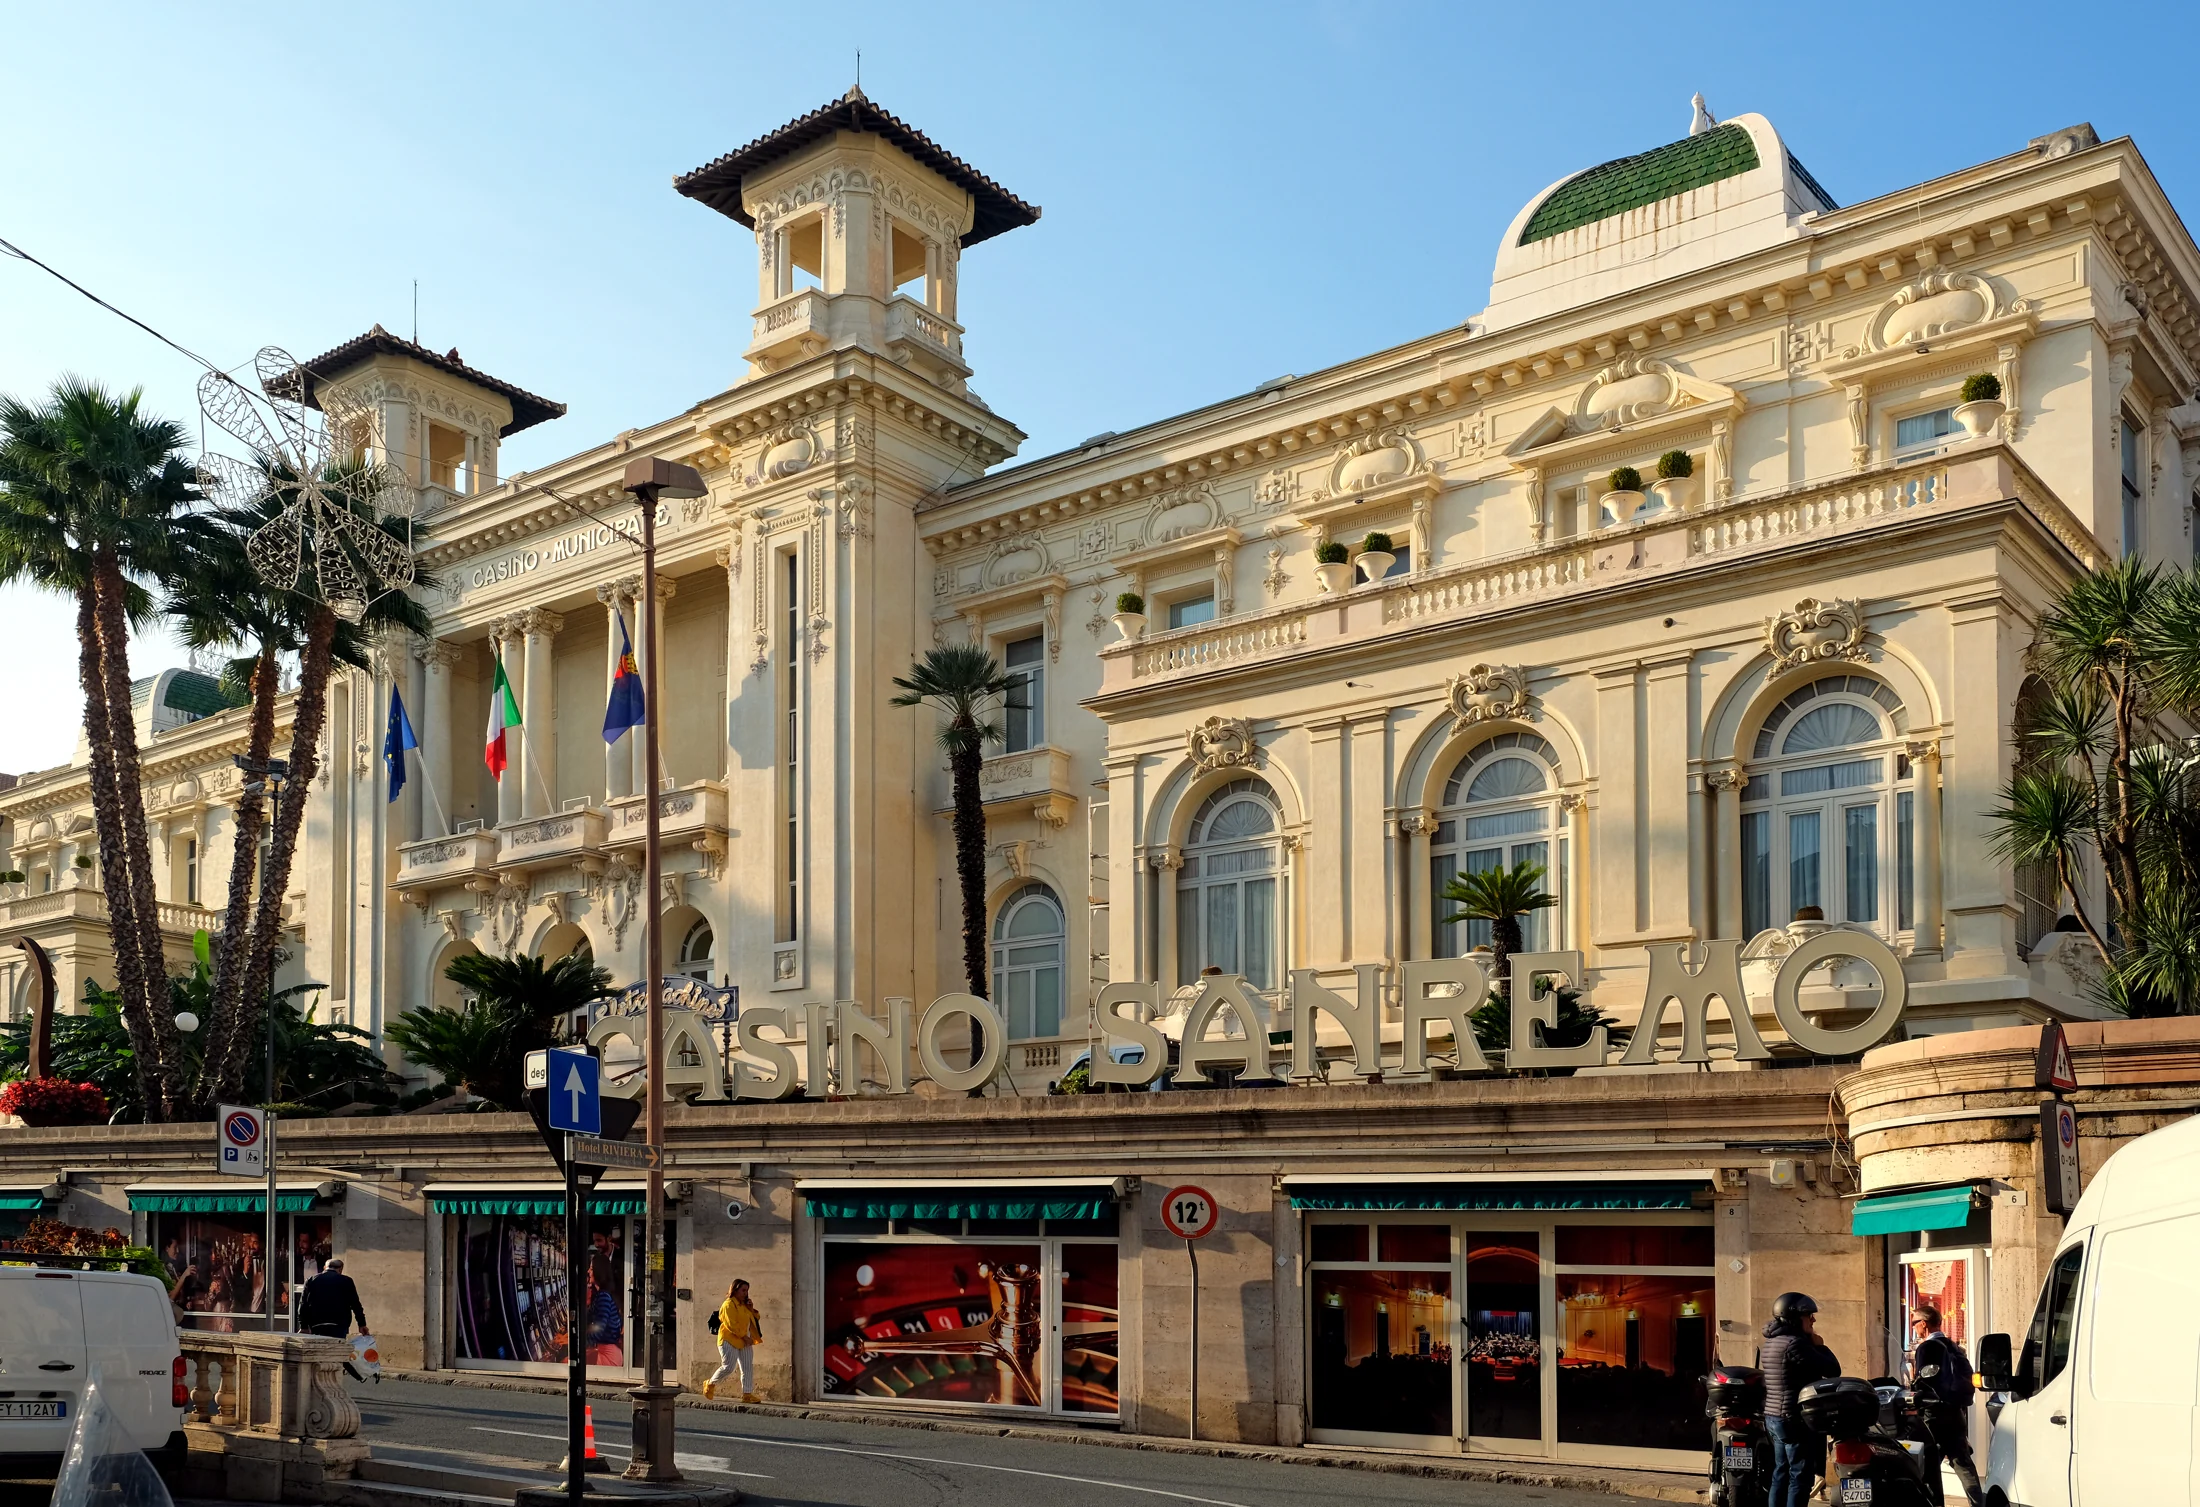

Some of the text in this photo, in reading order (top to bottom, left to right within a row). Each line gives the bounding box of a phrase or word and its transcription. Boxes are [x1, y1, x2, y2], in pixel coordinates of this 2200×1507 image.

[472, 504, 671, 588] CASINO MUNICIPAE
[1090, 930, 1908, 1086] SANREMO
[586, 992, 1008, 1101] CASINO
[577, 1141, 643, 1159] Hotel RIVIERA
[2011, 1195, 2017, 1203] 6
[1729, 1208, 1735, 1216] 8
[1843, 1490, 1871, 1501] 54706
